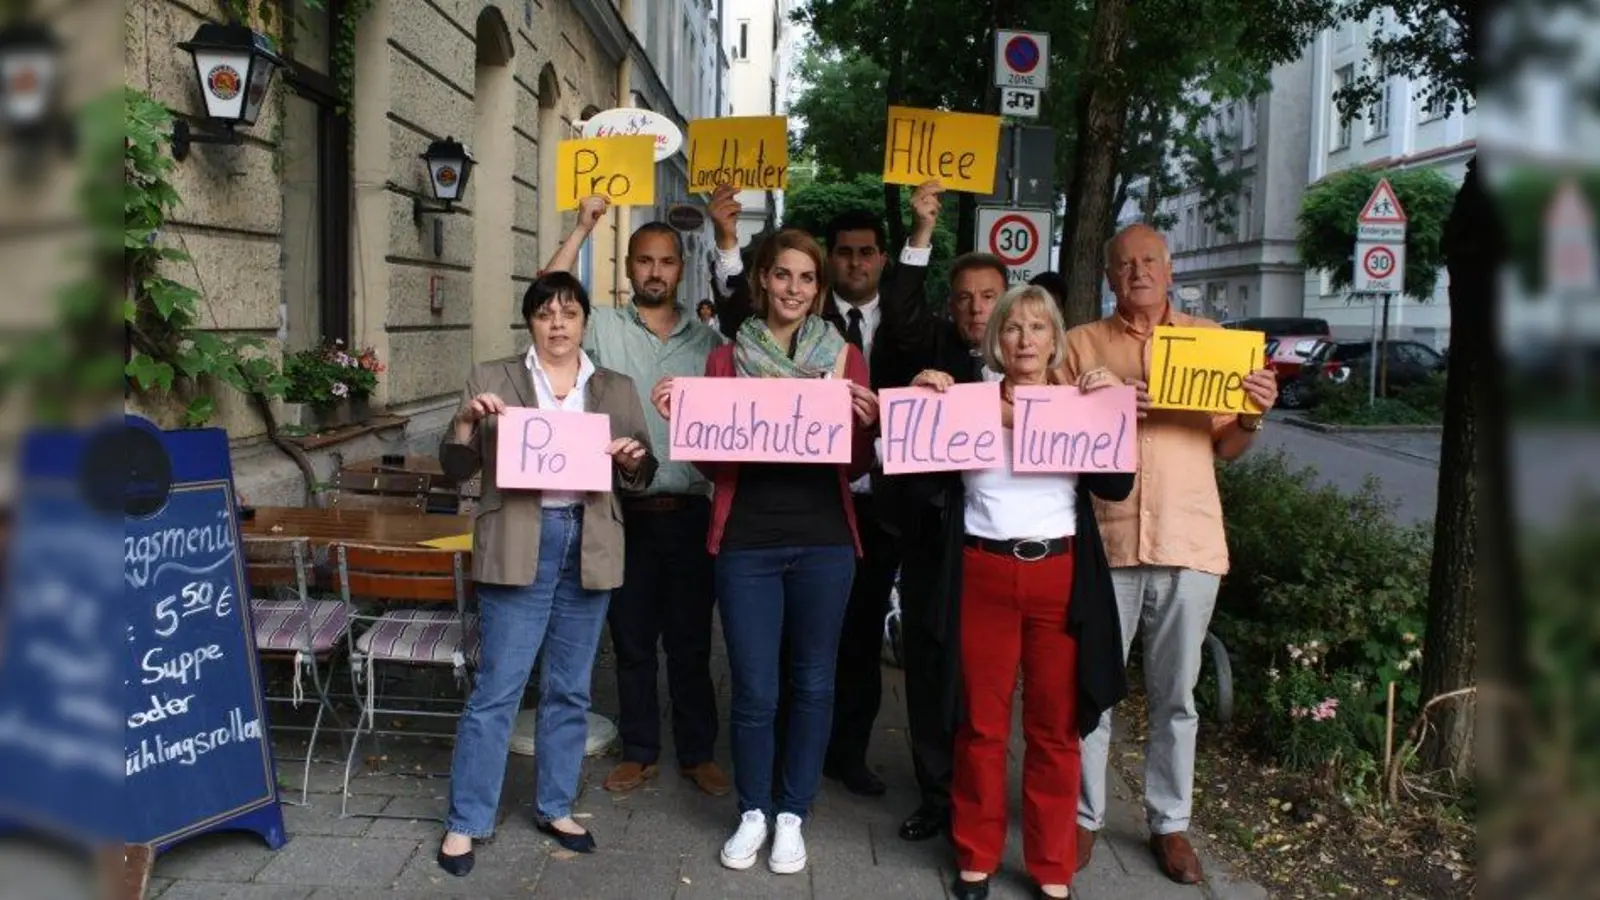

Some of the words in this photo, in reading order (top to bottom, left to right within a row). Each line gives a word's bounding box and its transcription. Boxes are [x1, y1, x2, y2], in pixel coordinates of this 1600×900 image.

[1008, 74, 1035, 85] ZONE
[573, 148, 630, 200] Pro
[689, 138, 788, 189] Landshuter
[1000, 228, 1028, 252] 30
[1006, 269, 1032, 282] ONE
[1371, 254, 1390, 271] 30
[673, 389, 845, 456] Landshuter
[1016, 397, 1126, 469] Tunnel
[520, 416, 566, 474] Pro
[142, 644, 224, 685] Suppe
[128, 693, 197, 729] oder
